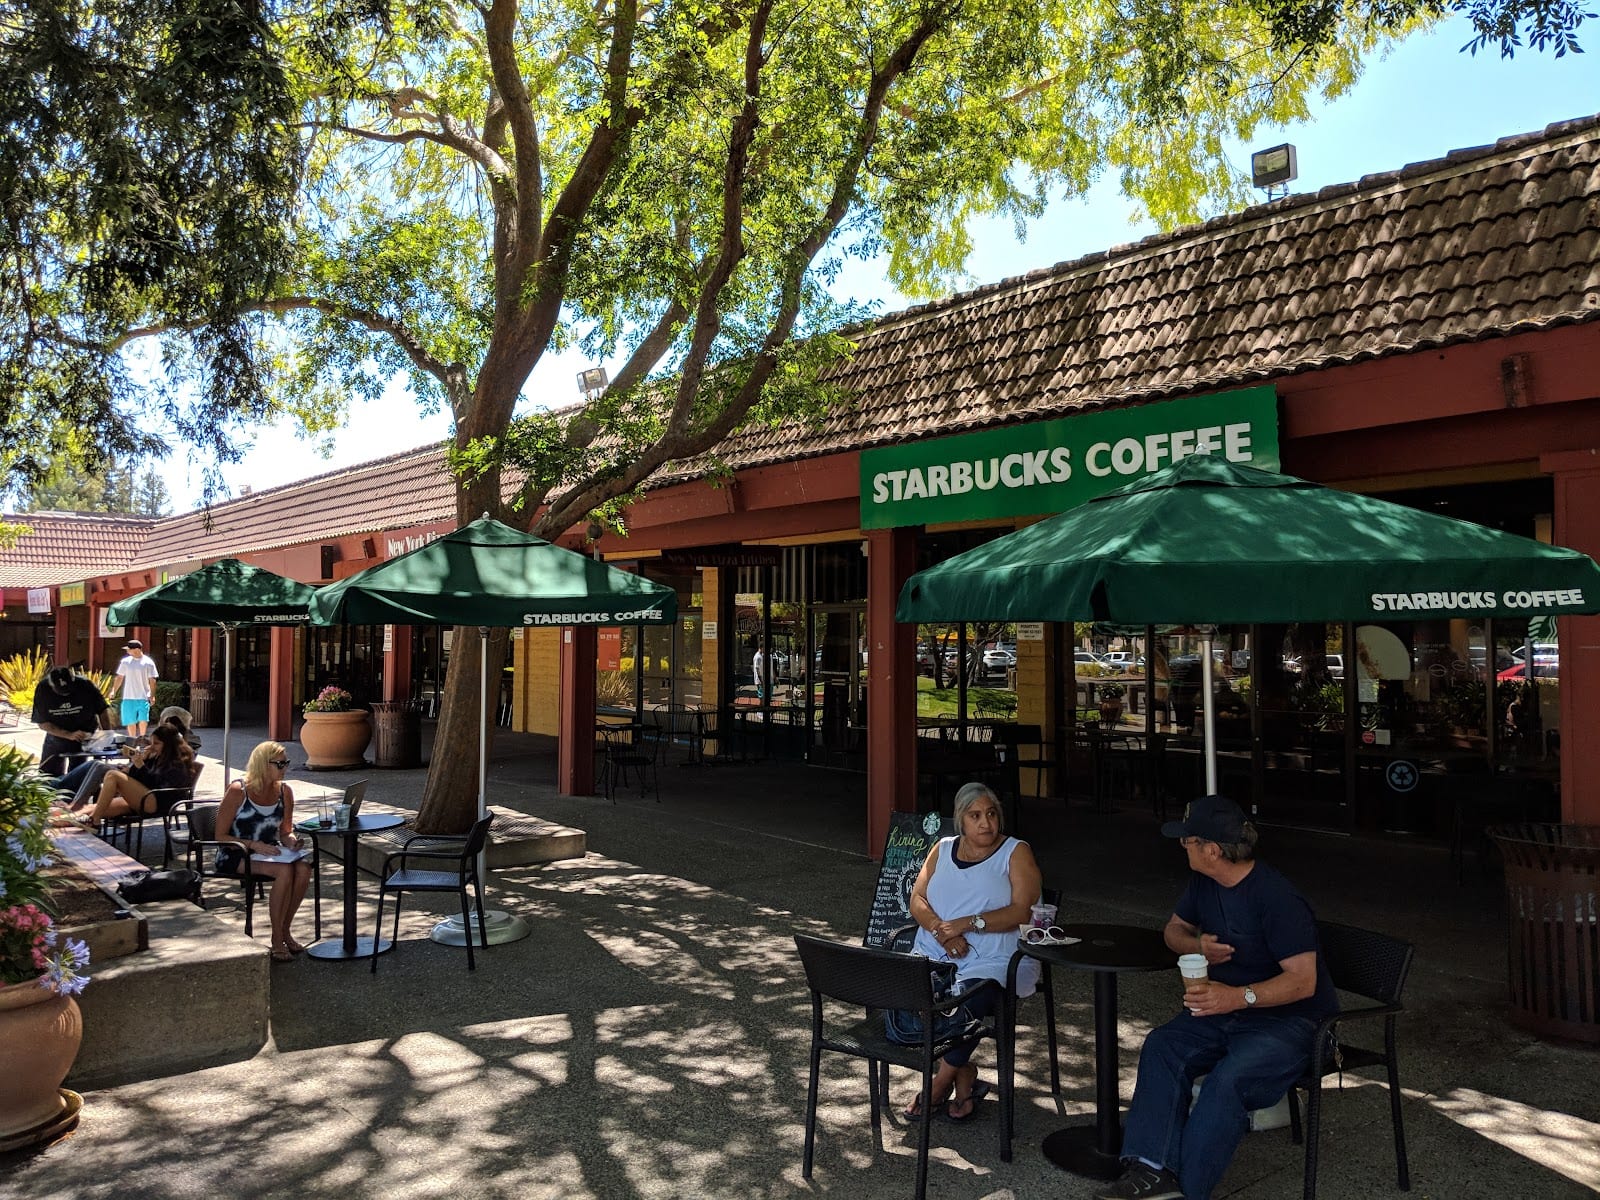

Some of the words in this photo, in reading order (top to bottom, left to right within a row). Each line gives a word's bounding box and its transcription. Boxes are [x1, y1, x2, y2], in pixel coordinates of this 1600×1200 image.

[872, 447, 1071, 504] STARBUCKS
[1085, 422, 1253, 478] COFFEE
[388, 538, 405, 557] New
[405, 534, 425, 552] York
[1371, 591, 1497, 611] STARBUCKS
[1503, 588, 1585, 609] COFFEE
[254, 613, 310, 622] STARBUCKS
[522, 612, 611, 625] STARBUCKS
[613, 609, 663, 621] COFFEE
[887, 826, 928, 857] hiring
